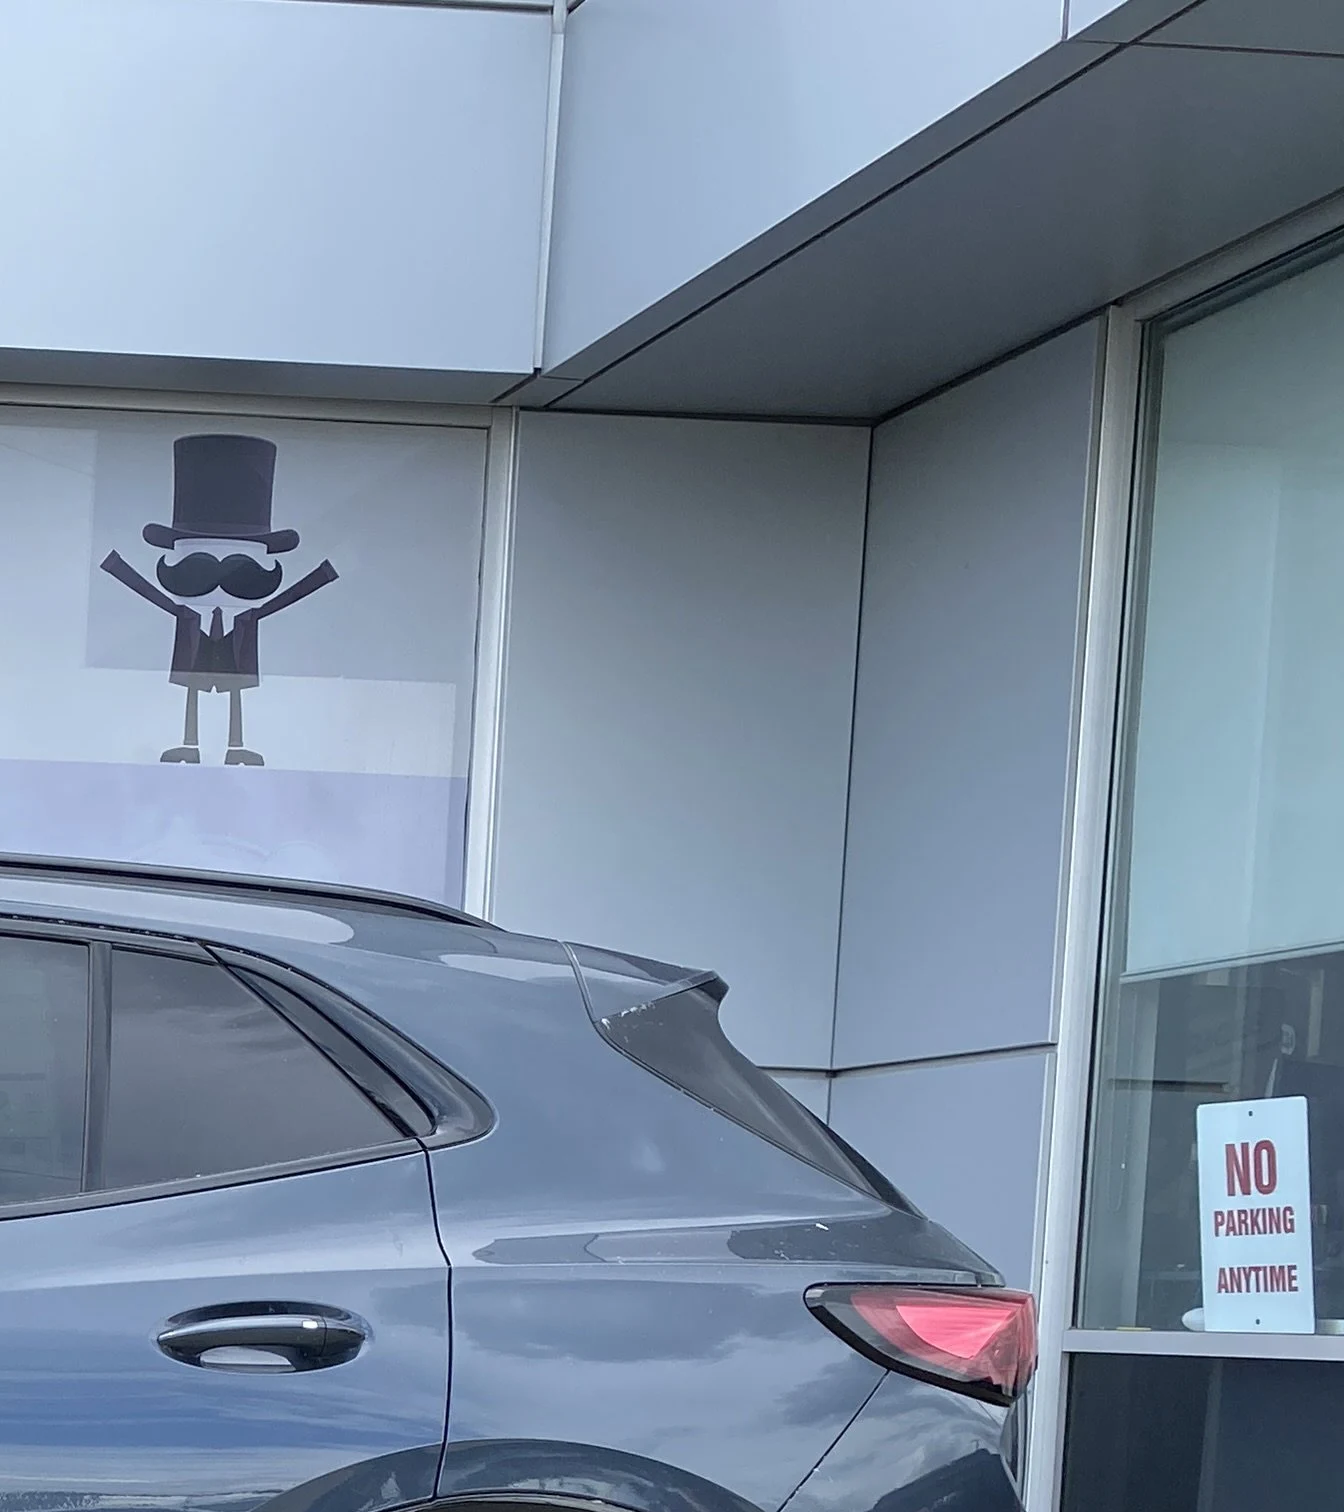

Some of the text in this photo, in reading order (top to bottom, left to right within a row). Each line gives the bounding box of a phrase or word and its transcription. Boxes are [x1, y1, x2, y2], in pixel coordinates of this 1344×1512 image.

[1224, 1139, 1278, 1197] NO
[1213, 1206, 1296, 1238] PARKING
[1216, 1264, 1300, 1294] ANYTIME
